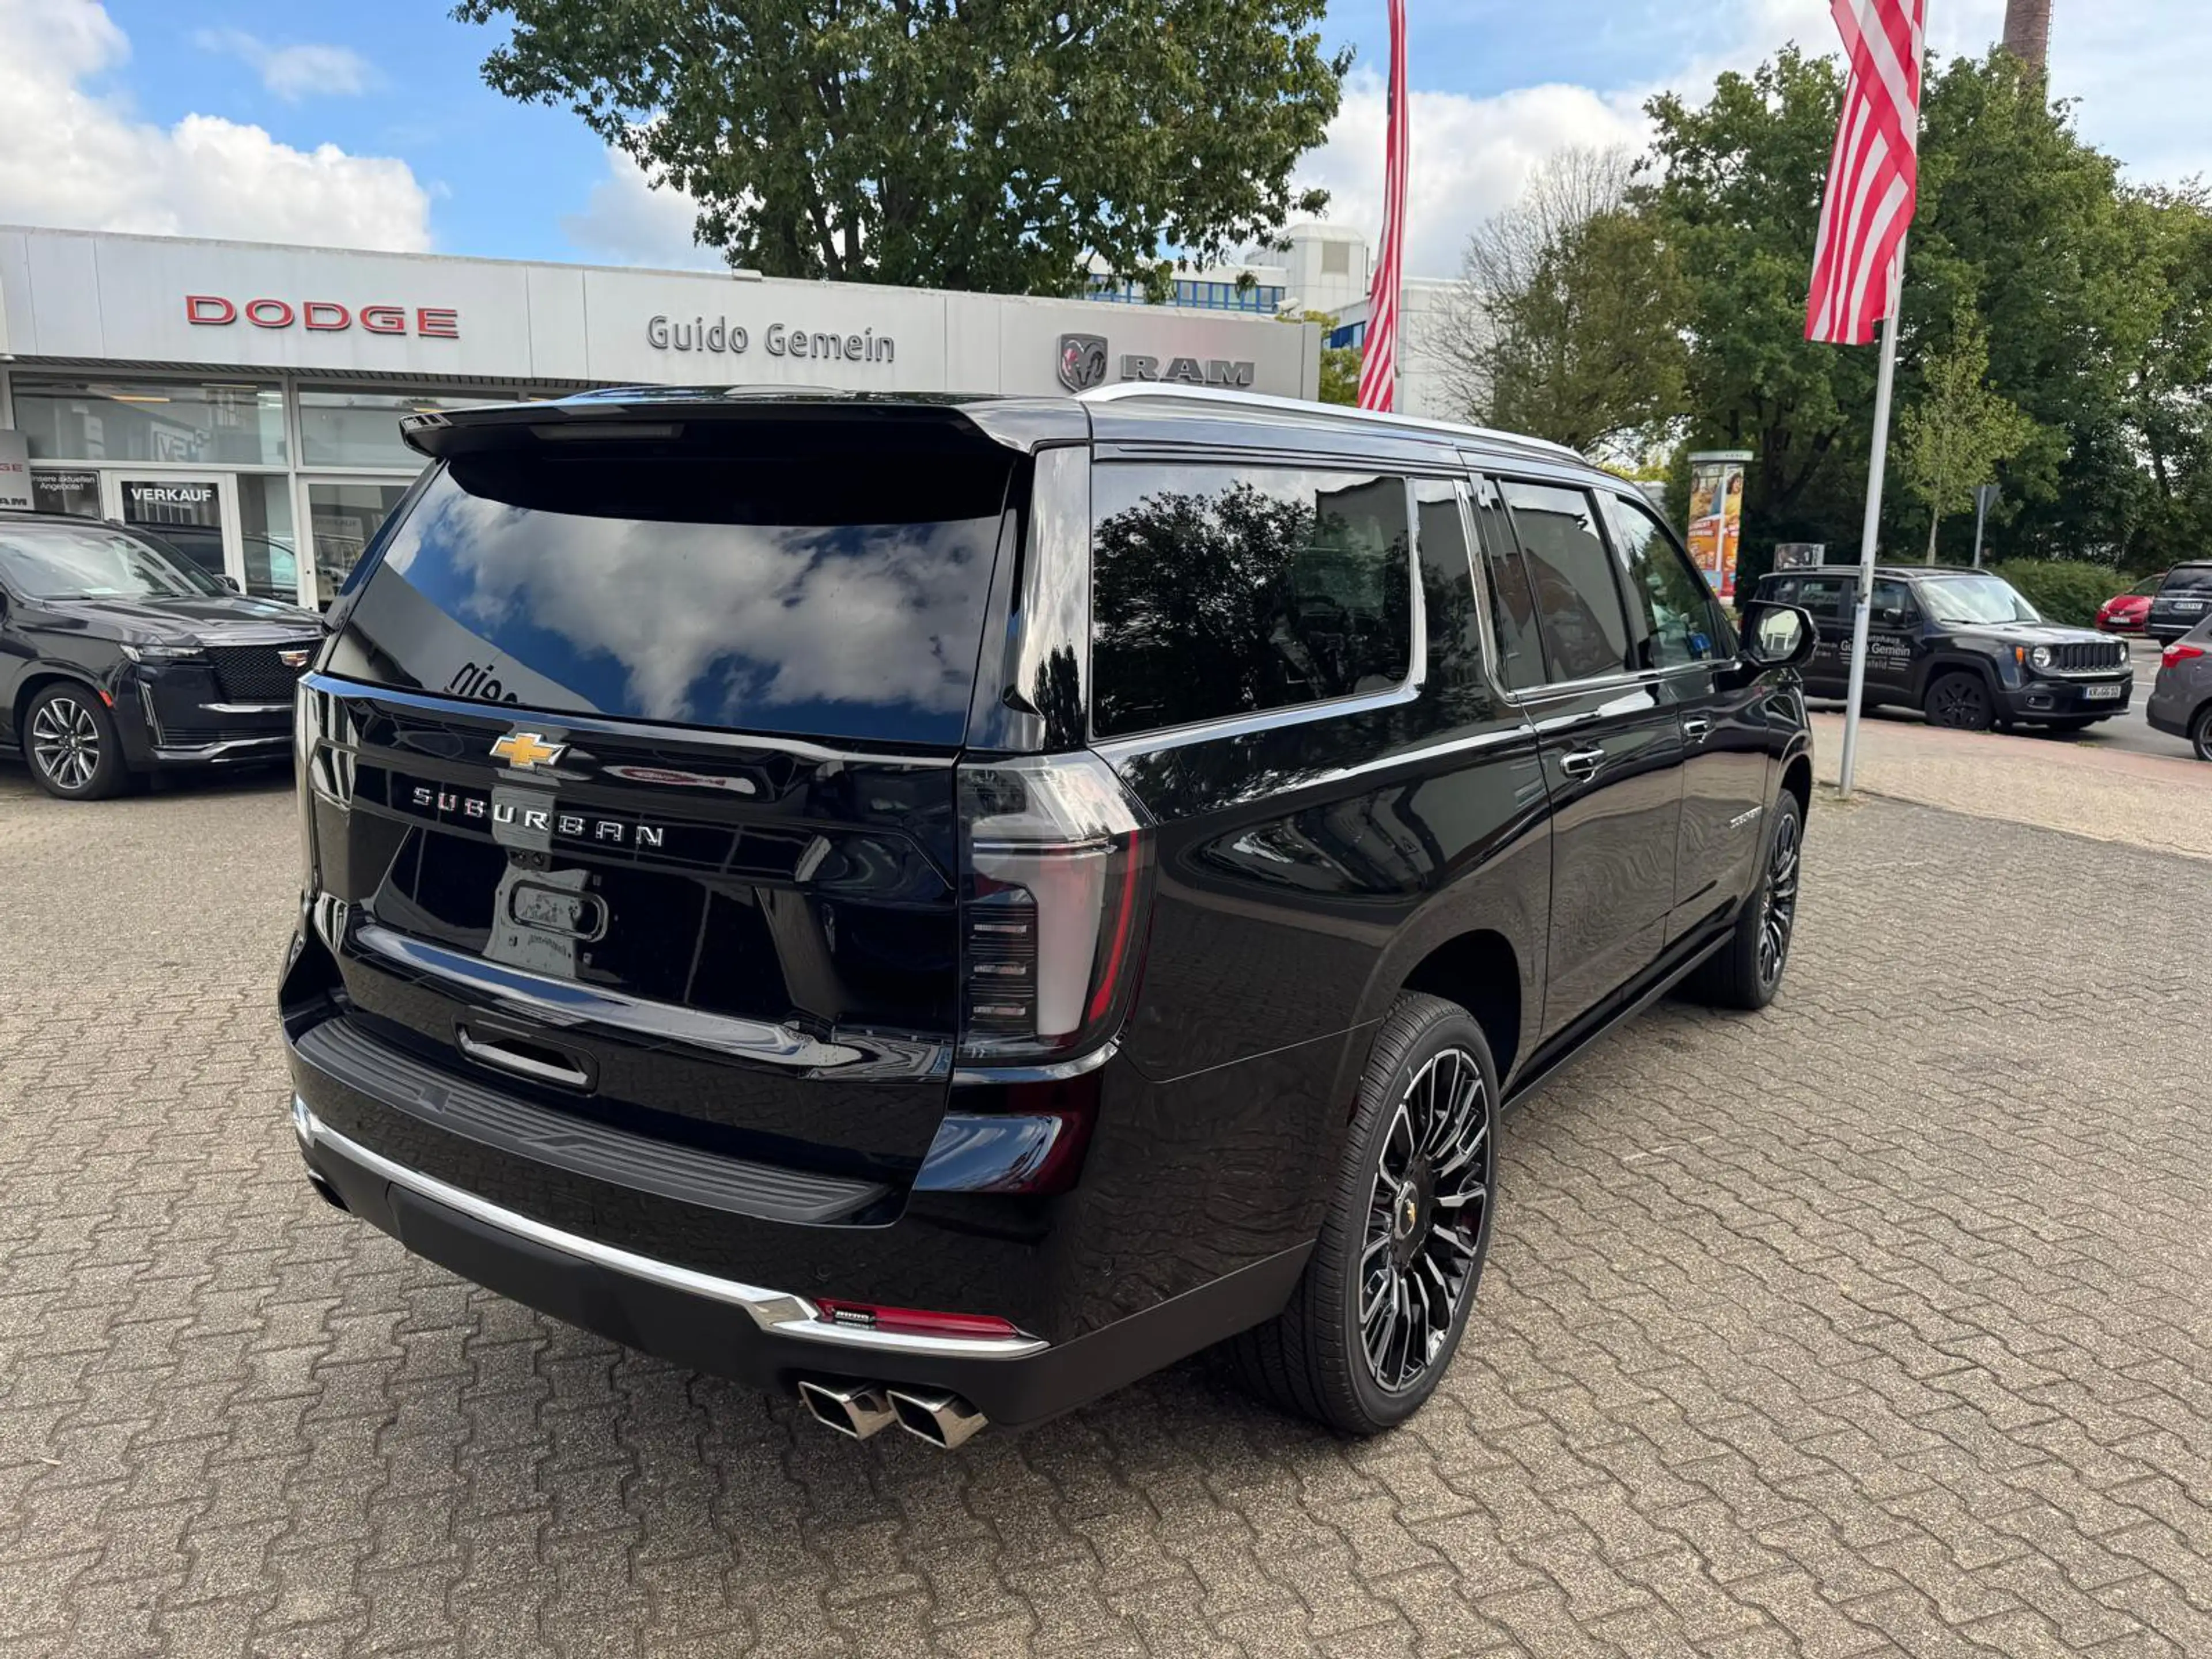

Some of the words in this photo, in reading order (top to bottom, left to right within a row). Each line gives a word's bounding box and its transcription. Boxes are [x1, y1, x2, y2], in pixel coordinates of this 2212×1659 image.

[186, 296, 460, 338] DODGE
[647, 315, 748, 353] Guido
[765, 323, 894, 362] Gemein
[1120, 354, 1255, 387] RAM
[131, 488, 211, 502] VERKAUF
[1872, 642, 1910, 657] Gemein
[412, 786, 663, 847] SUBURBAN
